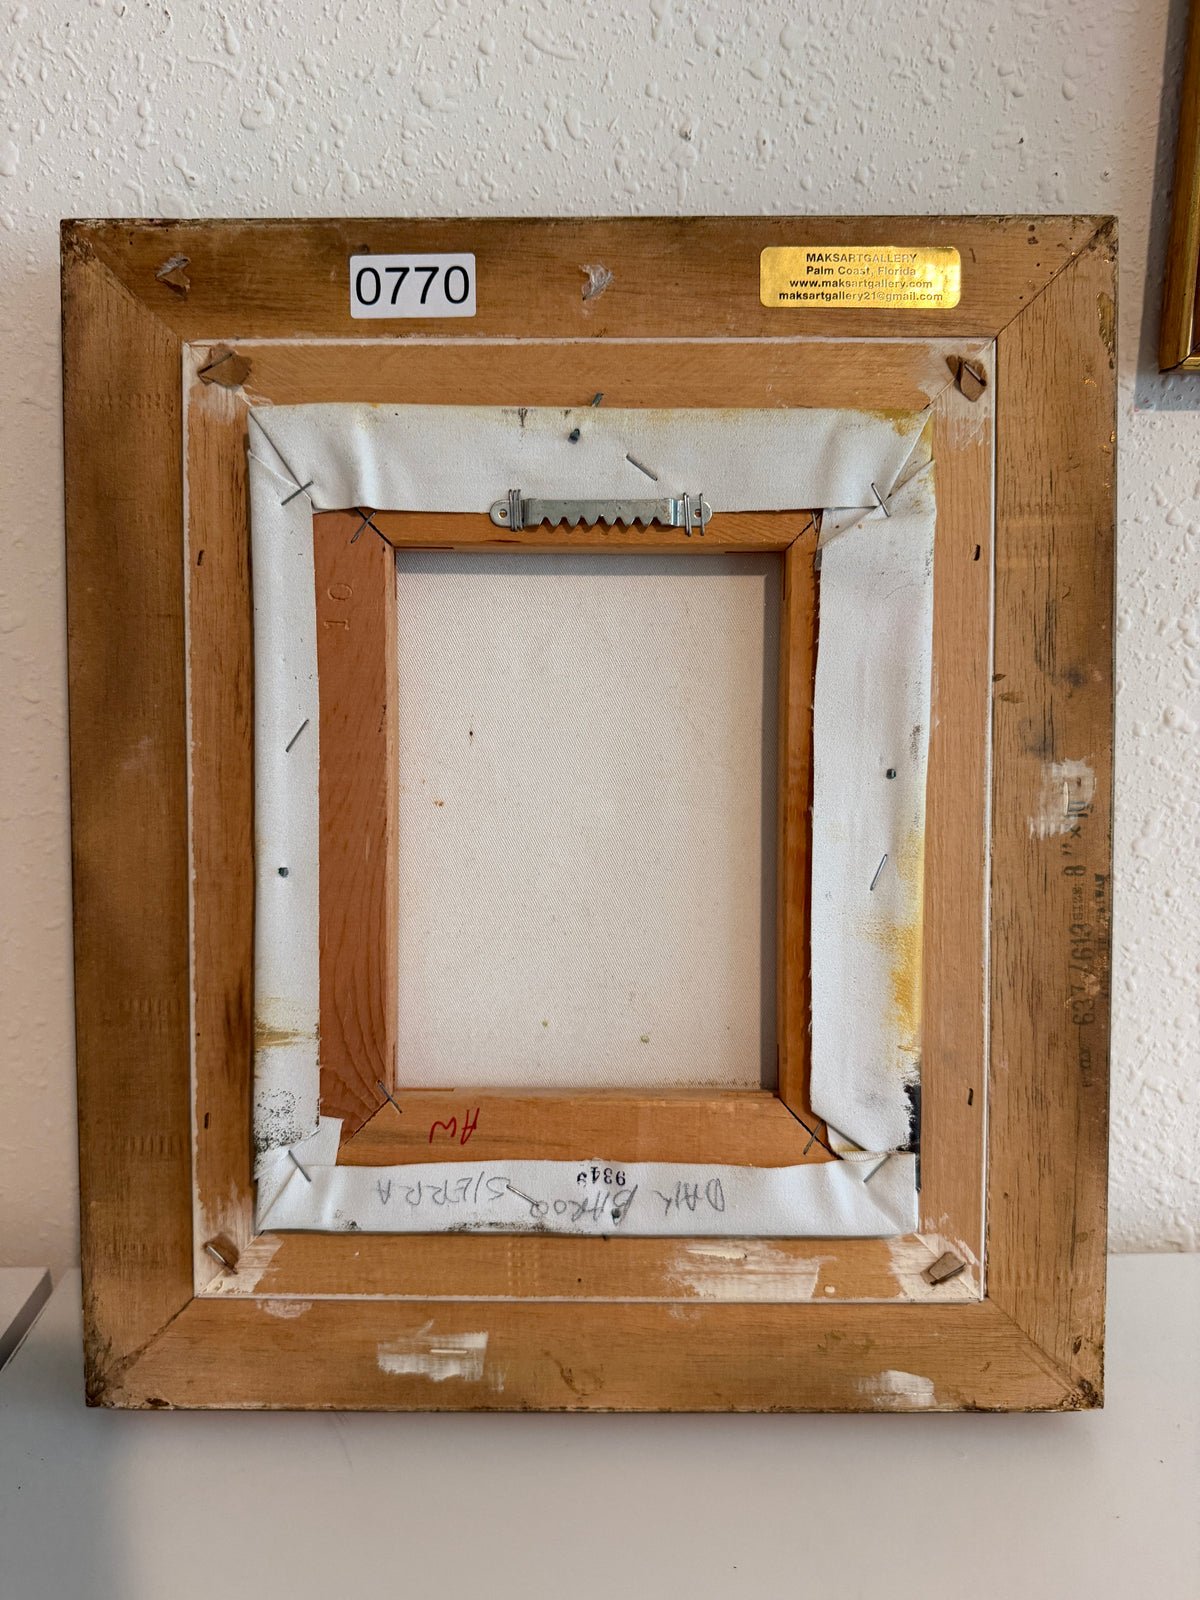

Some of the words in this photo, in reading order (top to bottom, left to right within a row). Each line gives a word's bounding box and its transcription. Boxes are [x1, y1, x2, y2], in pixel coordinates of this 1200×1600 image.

[806, 253, 918, 263] MAKSARTGALLERY
[806, 266, 834, 275] Palm
[838, 266, 875, 277] Coast,
[878, 266, 917, 276] Florida
[356, 265, 470, 305] 0770
[789, 280, 933, 289] www.maksartgallery.com
[778, 292, 944, 302] maksartgallery21@gmail.com
